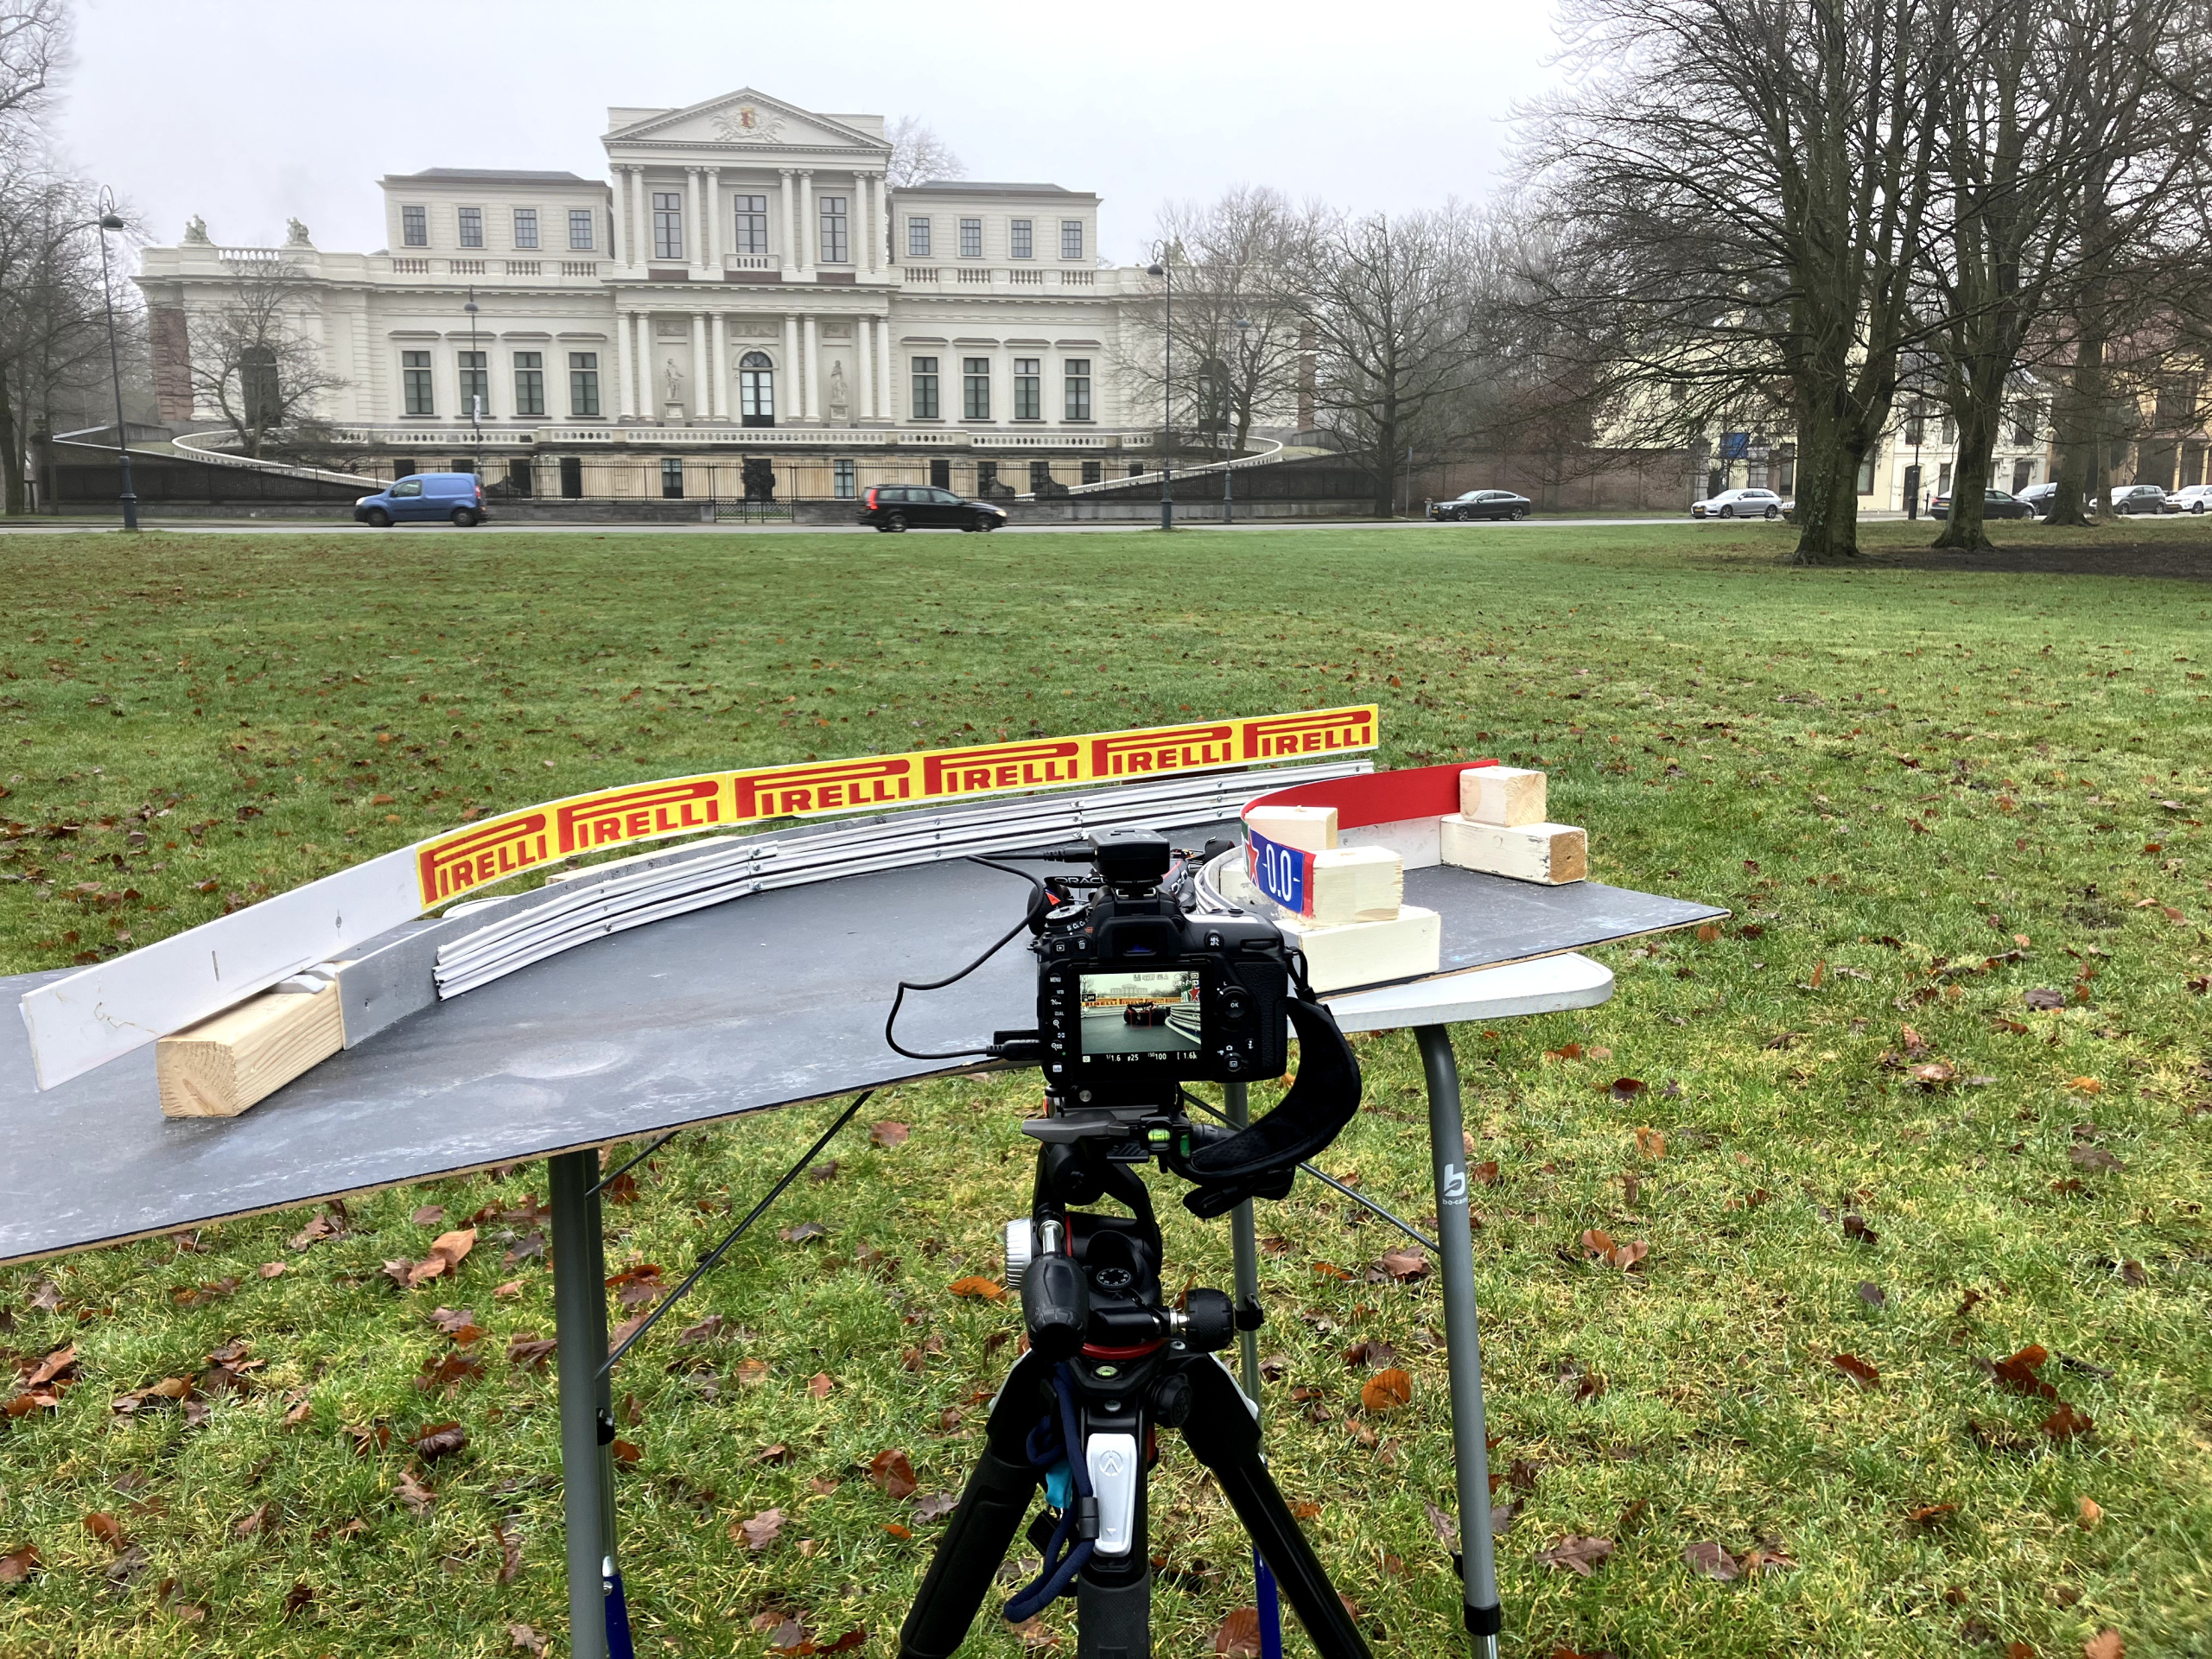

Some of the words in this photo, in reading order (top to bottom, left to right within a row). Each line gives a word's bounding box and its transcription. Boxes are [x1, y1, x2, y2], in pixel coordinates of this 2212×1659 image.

[419, 814, 546, 905] PIRELLI
[557, 781, 718, 854] PIRELLI
[734, 760, 912, 818] PIRELLI
[924, 742, 1079, 795] PIRELLI
[1091, 726, 1233, 777] PIRELLI
[1243, 710, 1372, 759] PIRELLI
